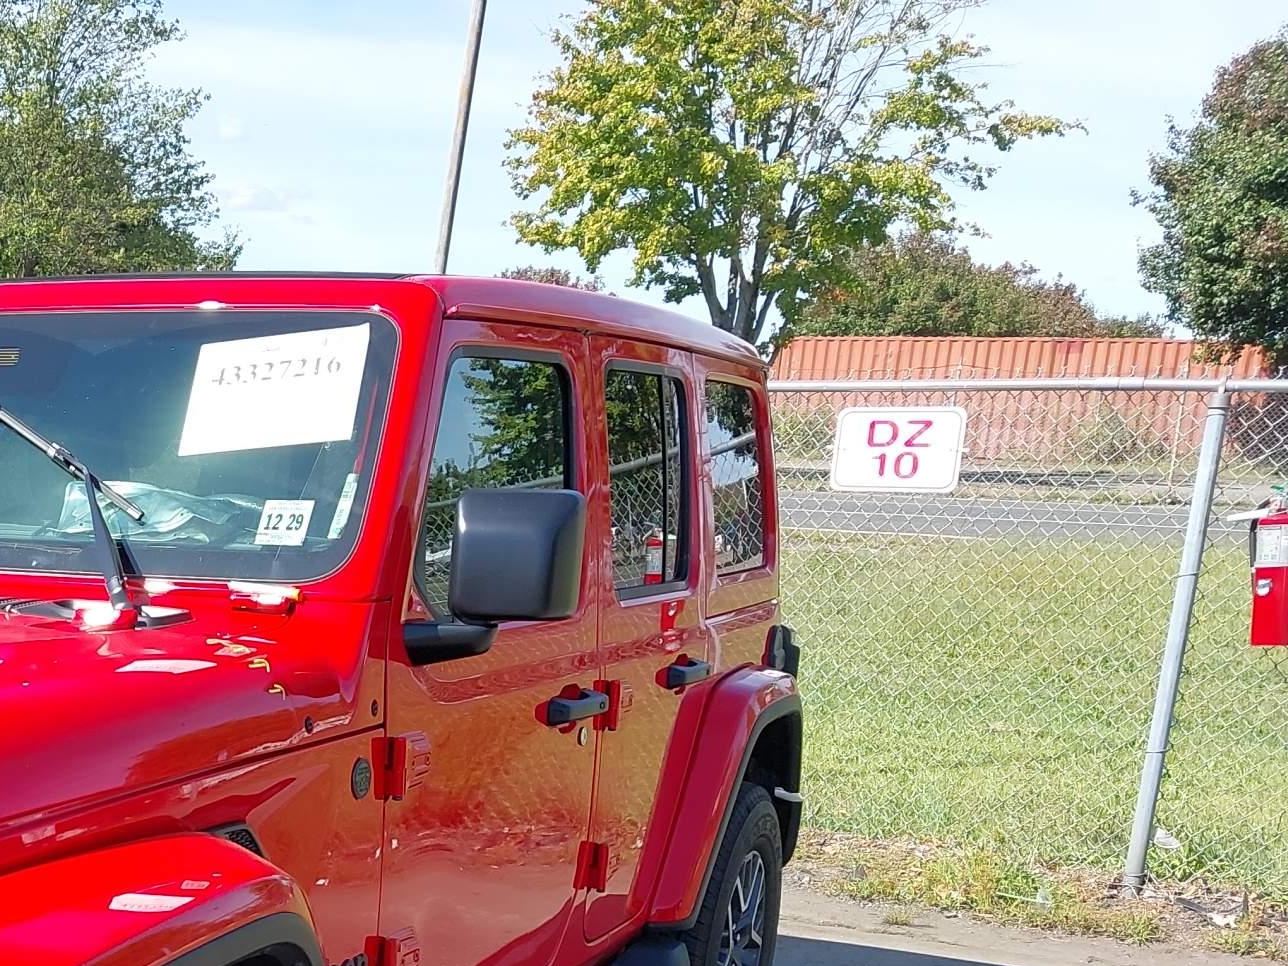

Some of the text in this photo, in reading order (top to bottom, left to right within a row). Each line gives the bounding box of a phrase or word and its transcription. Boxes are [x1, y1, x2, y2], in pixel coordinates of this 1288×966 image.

[867, 420, 934, 447] DZ
[871, 451, 920, 479] 10
[263, 512, 305, 532] 12 29
